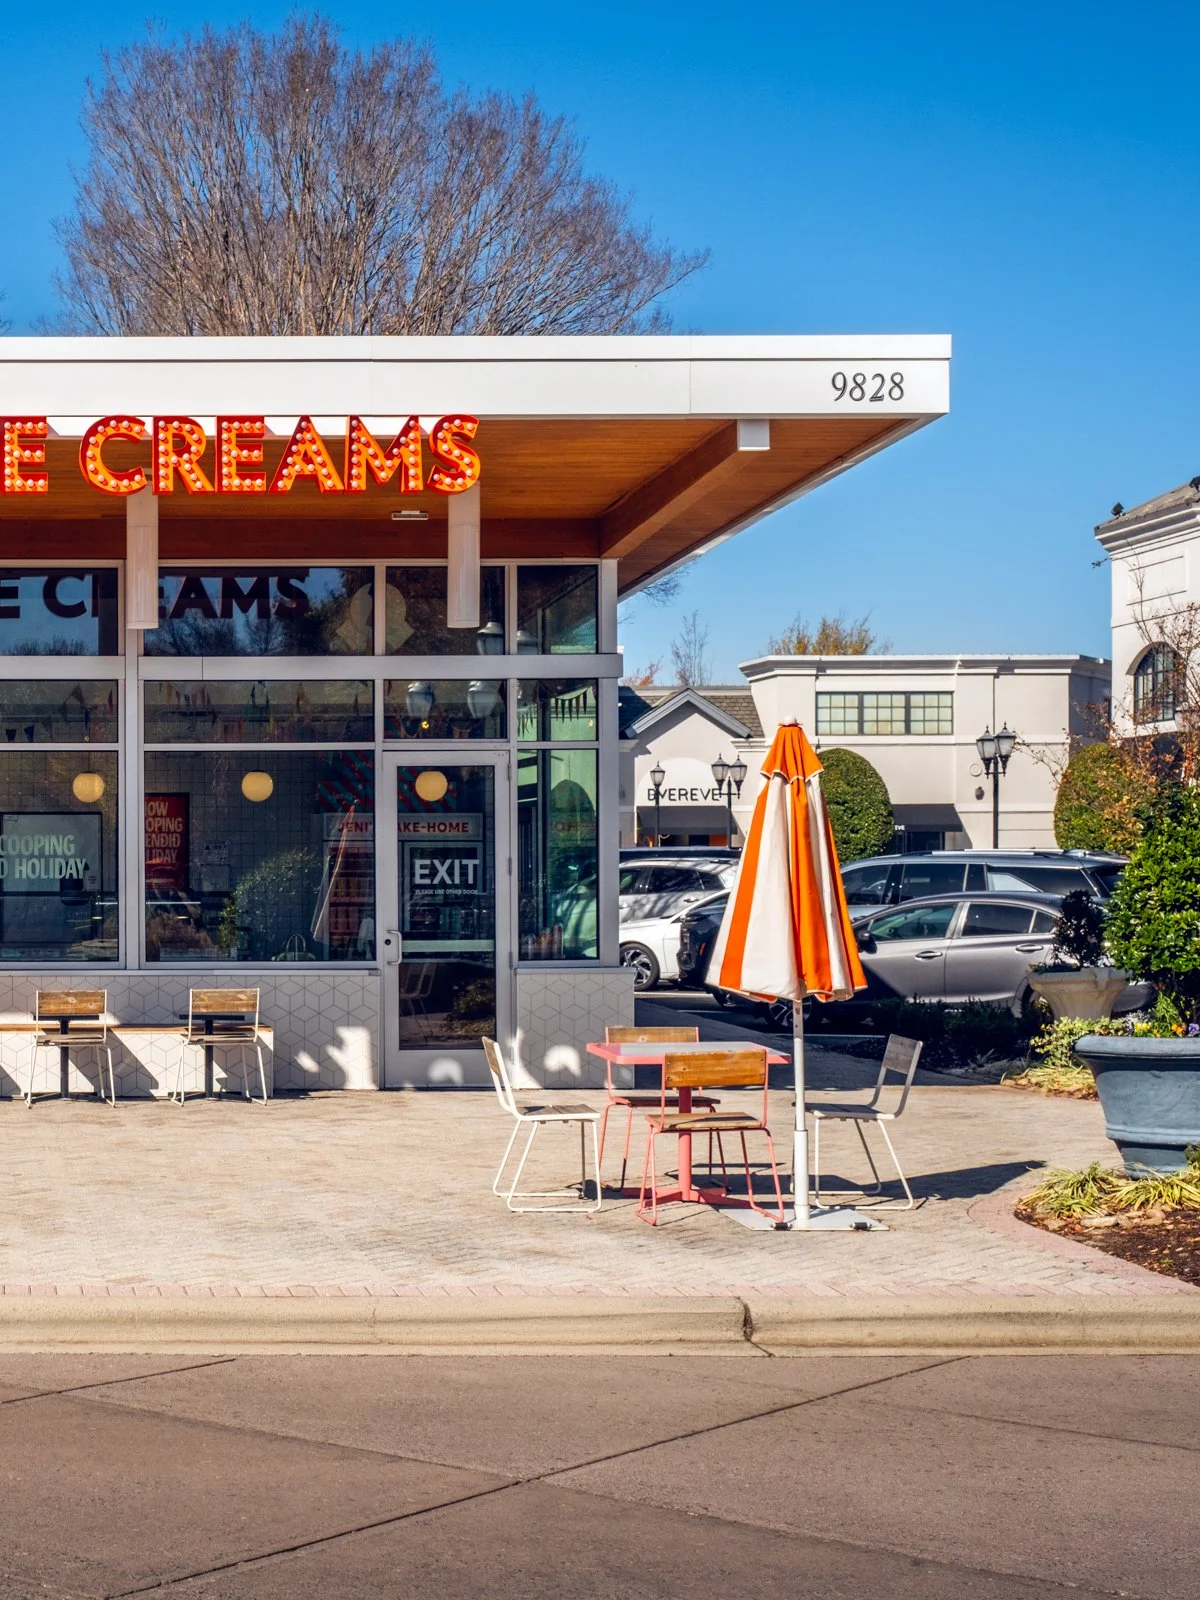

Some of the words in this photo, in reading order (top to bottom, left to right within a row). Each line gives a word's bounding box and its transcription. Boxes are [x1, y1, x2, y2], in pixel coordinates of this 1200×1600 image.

[831, 371, 905, 402] 9828
[79, 414, 481, 496] CREAMS
[145, 818, 183, 832] OPING
[14, 857, 88, 879] HOLIDAY
[414, 859, 480, 884] EXIT
